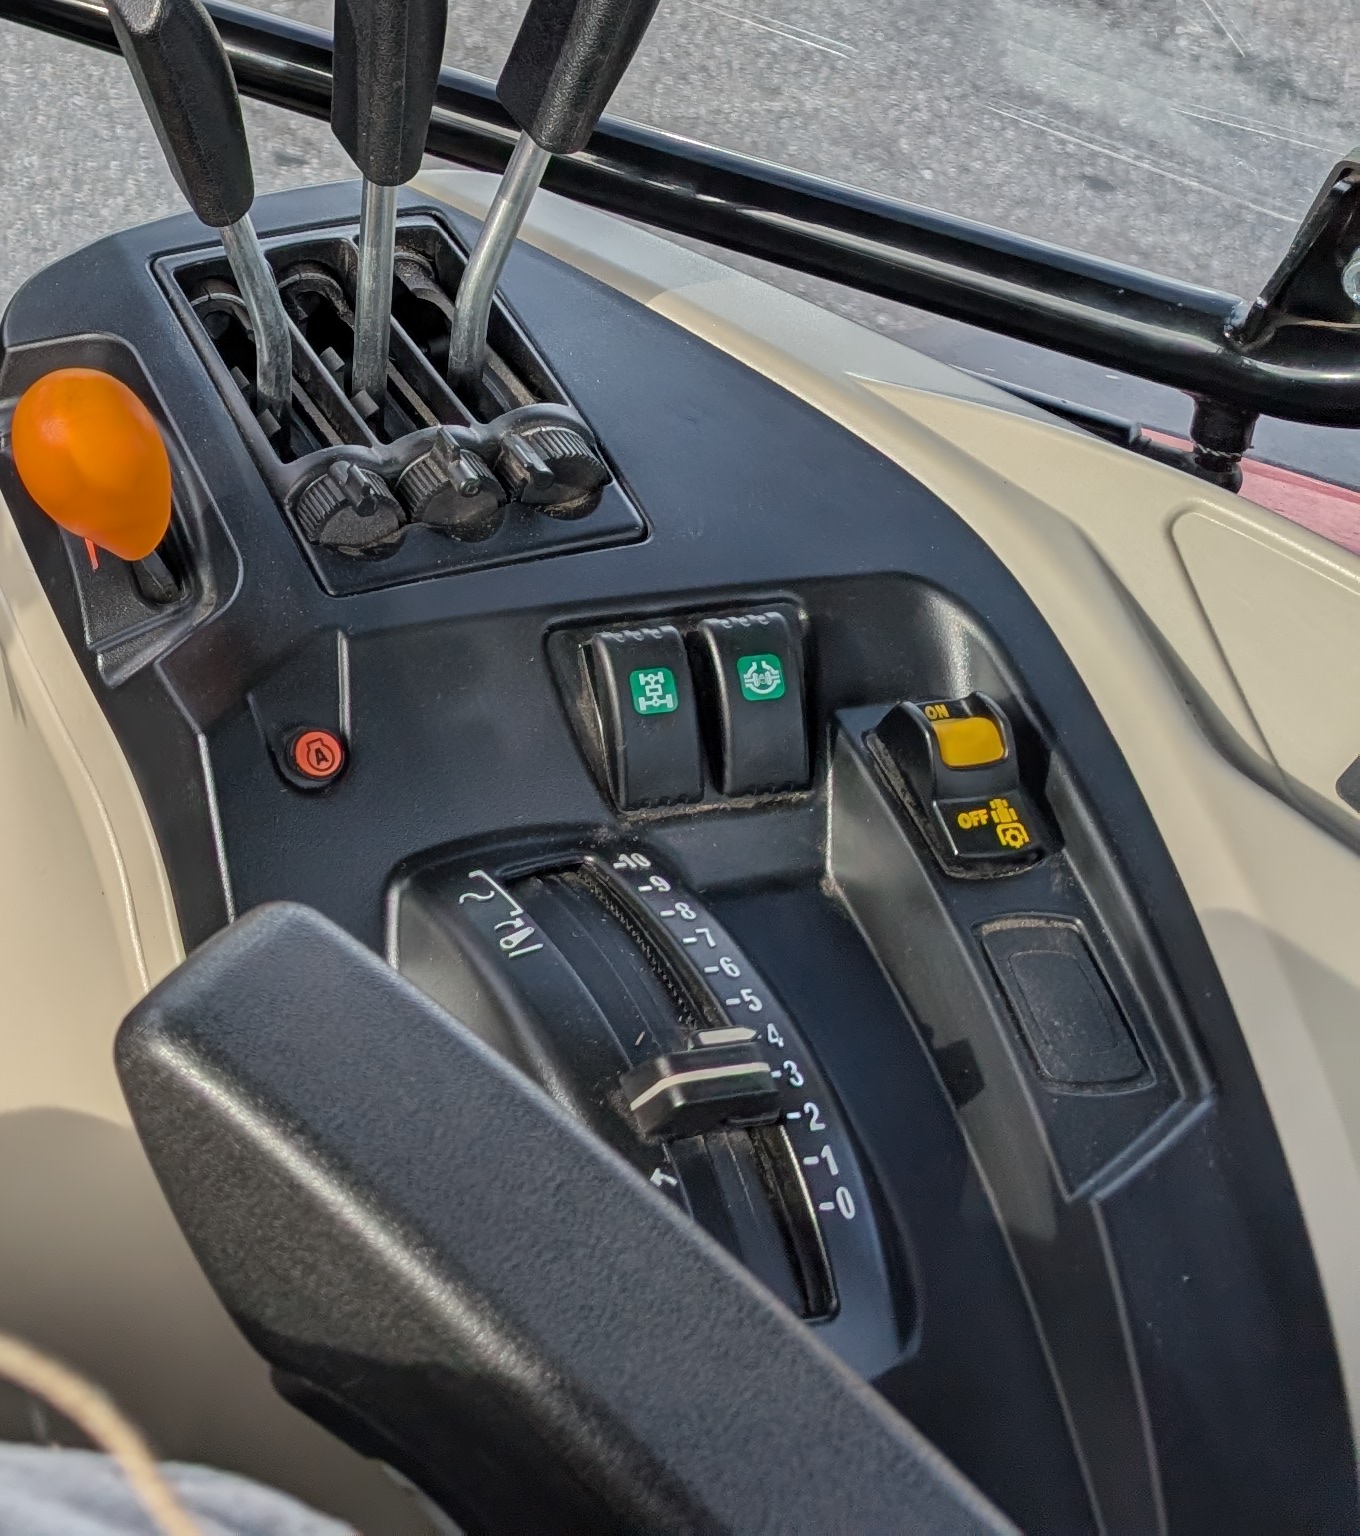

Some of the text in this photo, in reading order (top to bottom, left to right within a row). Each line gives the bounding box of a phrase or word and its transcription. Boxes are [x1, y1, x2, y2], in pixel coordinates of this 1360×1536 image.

[924, 704, 950, 720] ON
[314, 747, 330, 766] A
[957, 808, 989, 829] OFF
[618, 852, 651, 868] 10
[649, 875, 671, 892] 9
[674, 902, 697, 920] 8
[695, 927, 716, 948] 7
[719, 956, 741, 977] 6
[740, 988, 763, 1012] 5
[767, 1022, 785, 1048] 4
[783, 1060, 805, 1087] 3
[803, 1101, 827, 1131] 2
[820, 1144, 839, 1176] 1
[835, 1186, 856, 1220] 0
